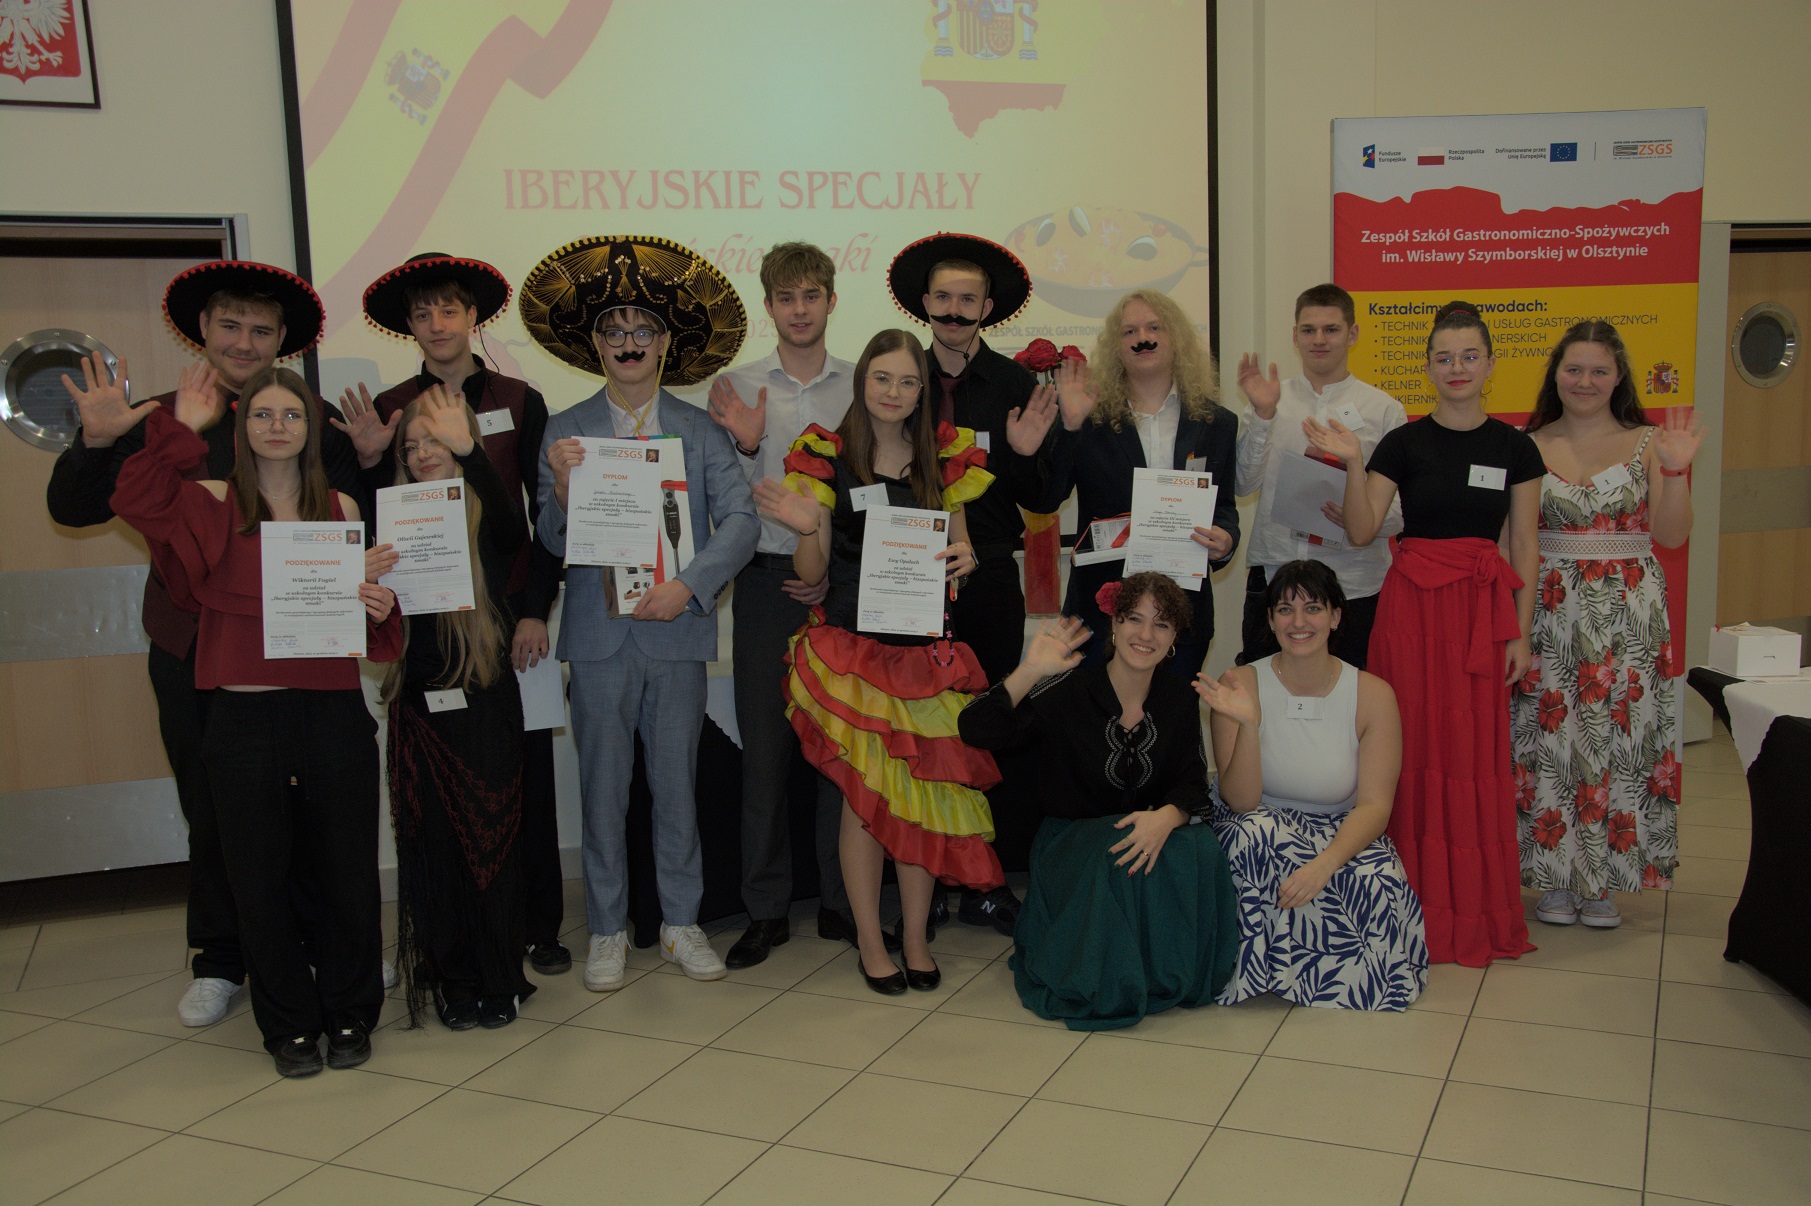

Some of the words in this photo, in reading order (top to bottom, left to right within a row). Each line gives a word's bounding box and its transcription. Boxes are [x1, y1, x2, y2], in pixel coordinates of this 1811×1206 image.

[1638, 143, 1673, 156] ZSGS
[503, 168, 764, 210] IBERYJSKIE
[778, 169, 982, 211] SPECJAŁY
[1361, 230, 1410, 246] Zespół
[1412, 229, 1451, 243] Szkół
[1453, 222, 1670, 242] Gastronomiczno-Spożywczych
[825, 232, 878, 274] aki
[1381, 250, 1404, 264] im.
[1406, 249, 1465, 265] Wisławy
[1468, 247, 1563, 264] Szymborskiej
[1566, 247, 1579, 258] w
[1582, 244, 1648, 260] Olsztynie
[1369, 302, 1440, 315] Kształcim
[1475, 299, 1547, 313] awodach:
[1381, 320, 1428, 331] TECHNIK
[1493, 318, 1532, 329] USŁUG
[1381, 335, 1428, 346] TECHNIK
[1492, 332, 1547, 344] NERSKICH
[1381, 351, 1428, 361] TECHNIK
[1511, 345, 1553, 358] ŻYWNO
[1381, 365, 1427, 376] KUCHAR
[1381, 380, 1422, 390] KELNER
[1395, 394, 1439, 405] KIERNIK
[487, 419, 493, 427] 5
[618, 449, 643, 459] ZSGS
[602, 473, 628, 481] DYPLOM
[1173, 477, 1195, 486] ZSGS
[420, 490, 445, 501] ZSGS
[861, 493, 866, 501] 7
[394, 515, 445, 526] PODZIĘKOWANIE
[907, 518, 931, 529] ZSGS
[315, 532, 343, 542] ZSGS
[882, 540, 928, 550] PODZIĘKOWANIE
[285, 559, 341, 567] PODZIĘKOWANIE
[438, 697, 444, 705] 4
